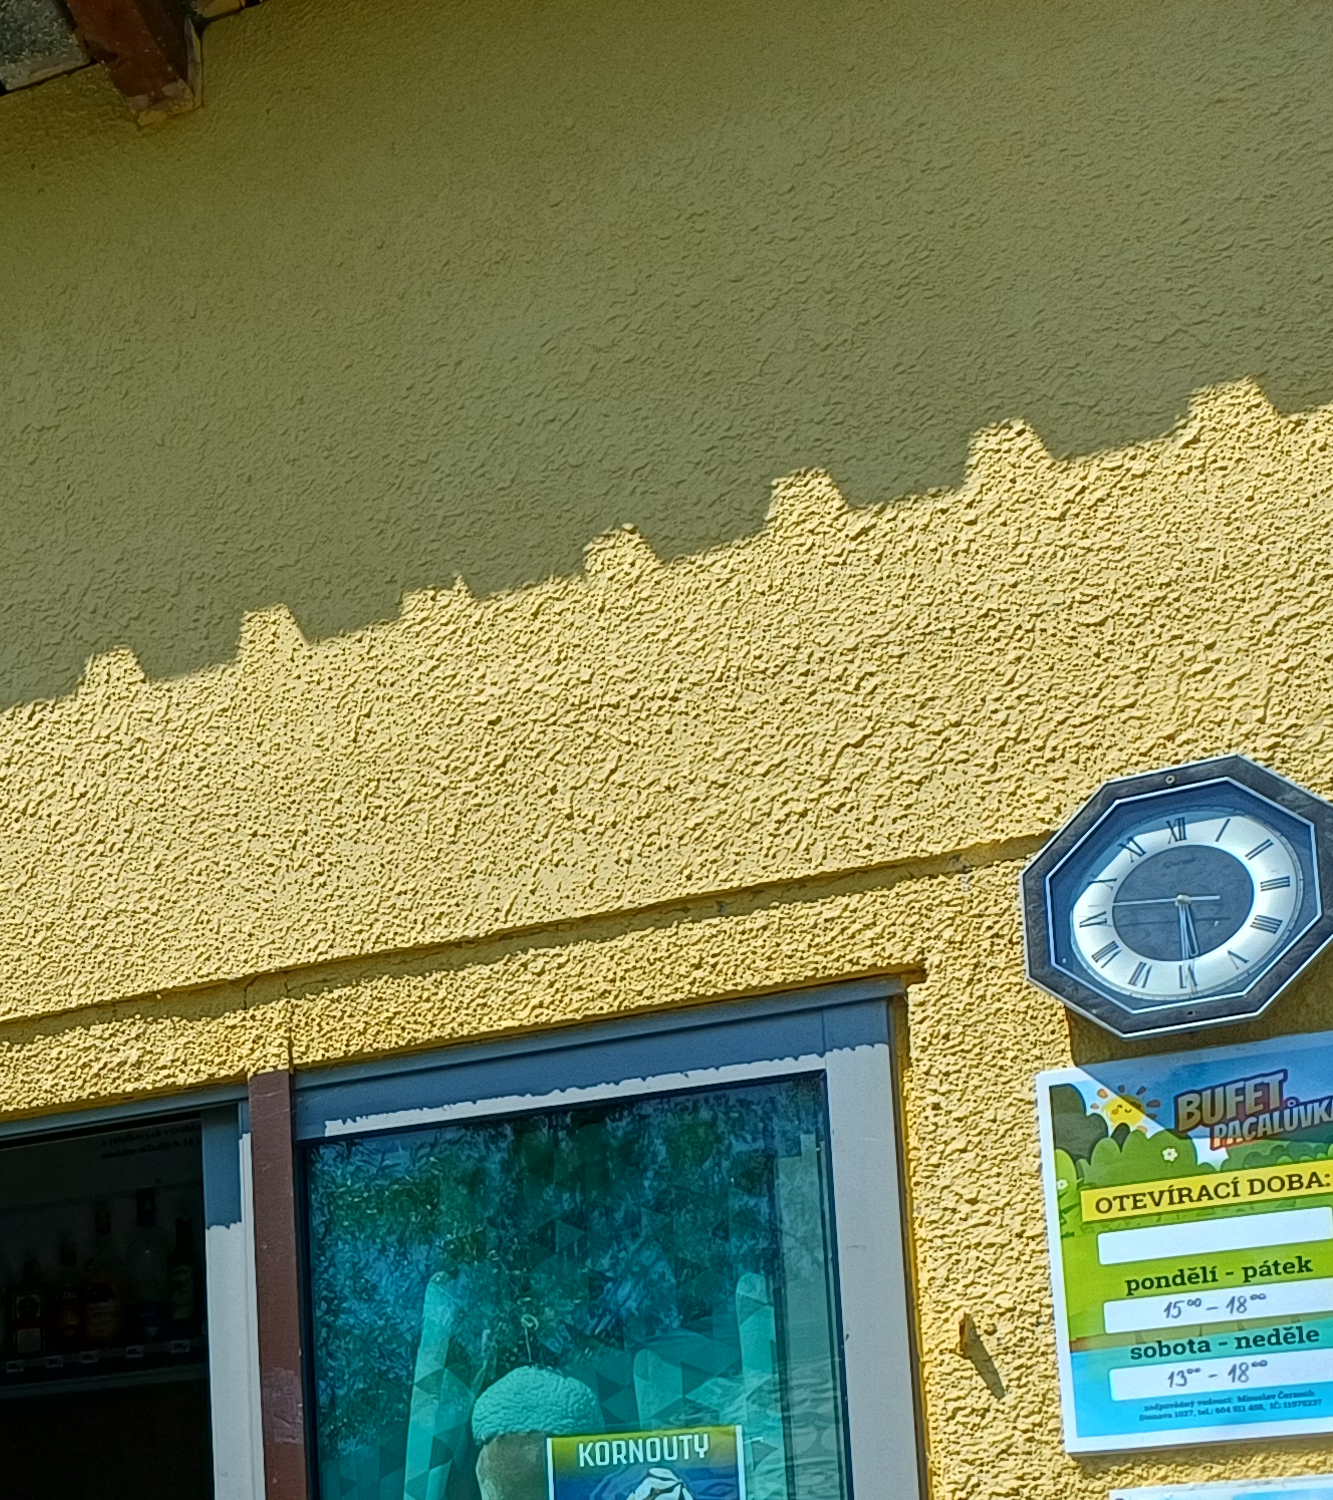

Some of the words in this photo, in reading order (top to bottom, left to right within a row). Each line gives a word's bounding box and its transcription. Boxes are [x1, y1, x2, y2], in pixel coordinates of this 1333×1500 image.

[1177, 1072, 1285, 1131] BUFET
[1095, 1176, 1240, 1214] OTEVÍRACÍ
[1247, 1172, 1331, 1196] DOBA:
[1126, 1266, 1219, 1295] pondělí
[1242, 1256, 1313, 1282] pátek
[1131, 1338, 1212, 1361] sobota
[1235, 1326, 1320, 1350] neděle
[578, 1433, 710, 1469] KORNOUTY
